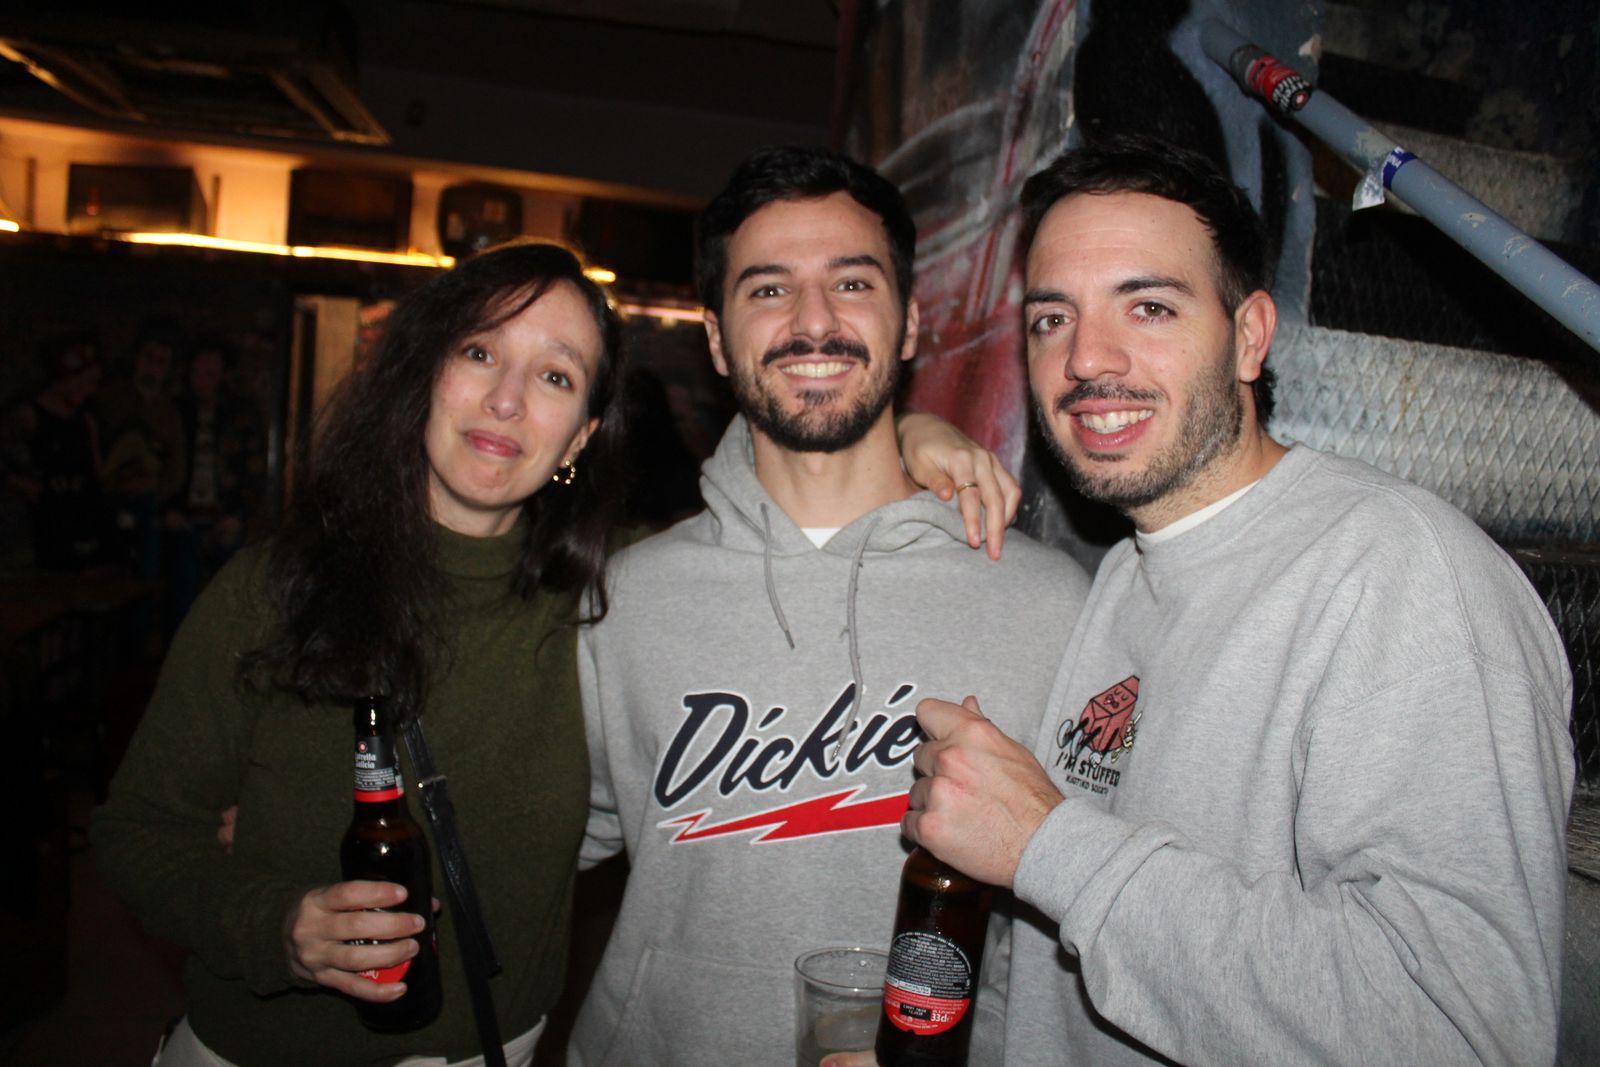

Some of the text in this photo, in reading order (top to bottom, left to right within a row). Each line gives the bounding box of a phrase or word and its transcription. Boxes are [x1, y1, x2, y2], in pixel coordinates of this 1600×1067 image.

[654, 682, 921, 808] Dickie
[1055, 751, 1121, 787] I'M STUFFED
